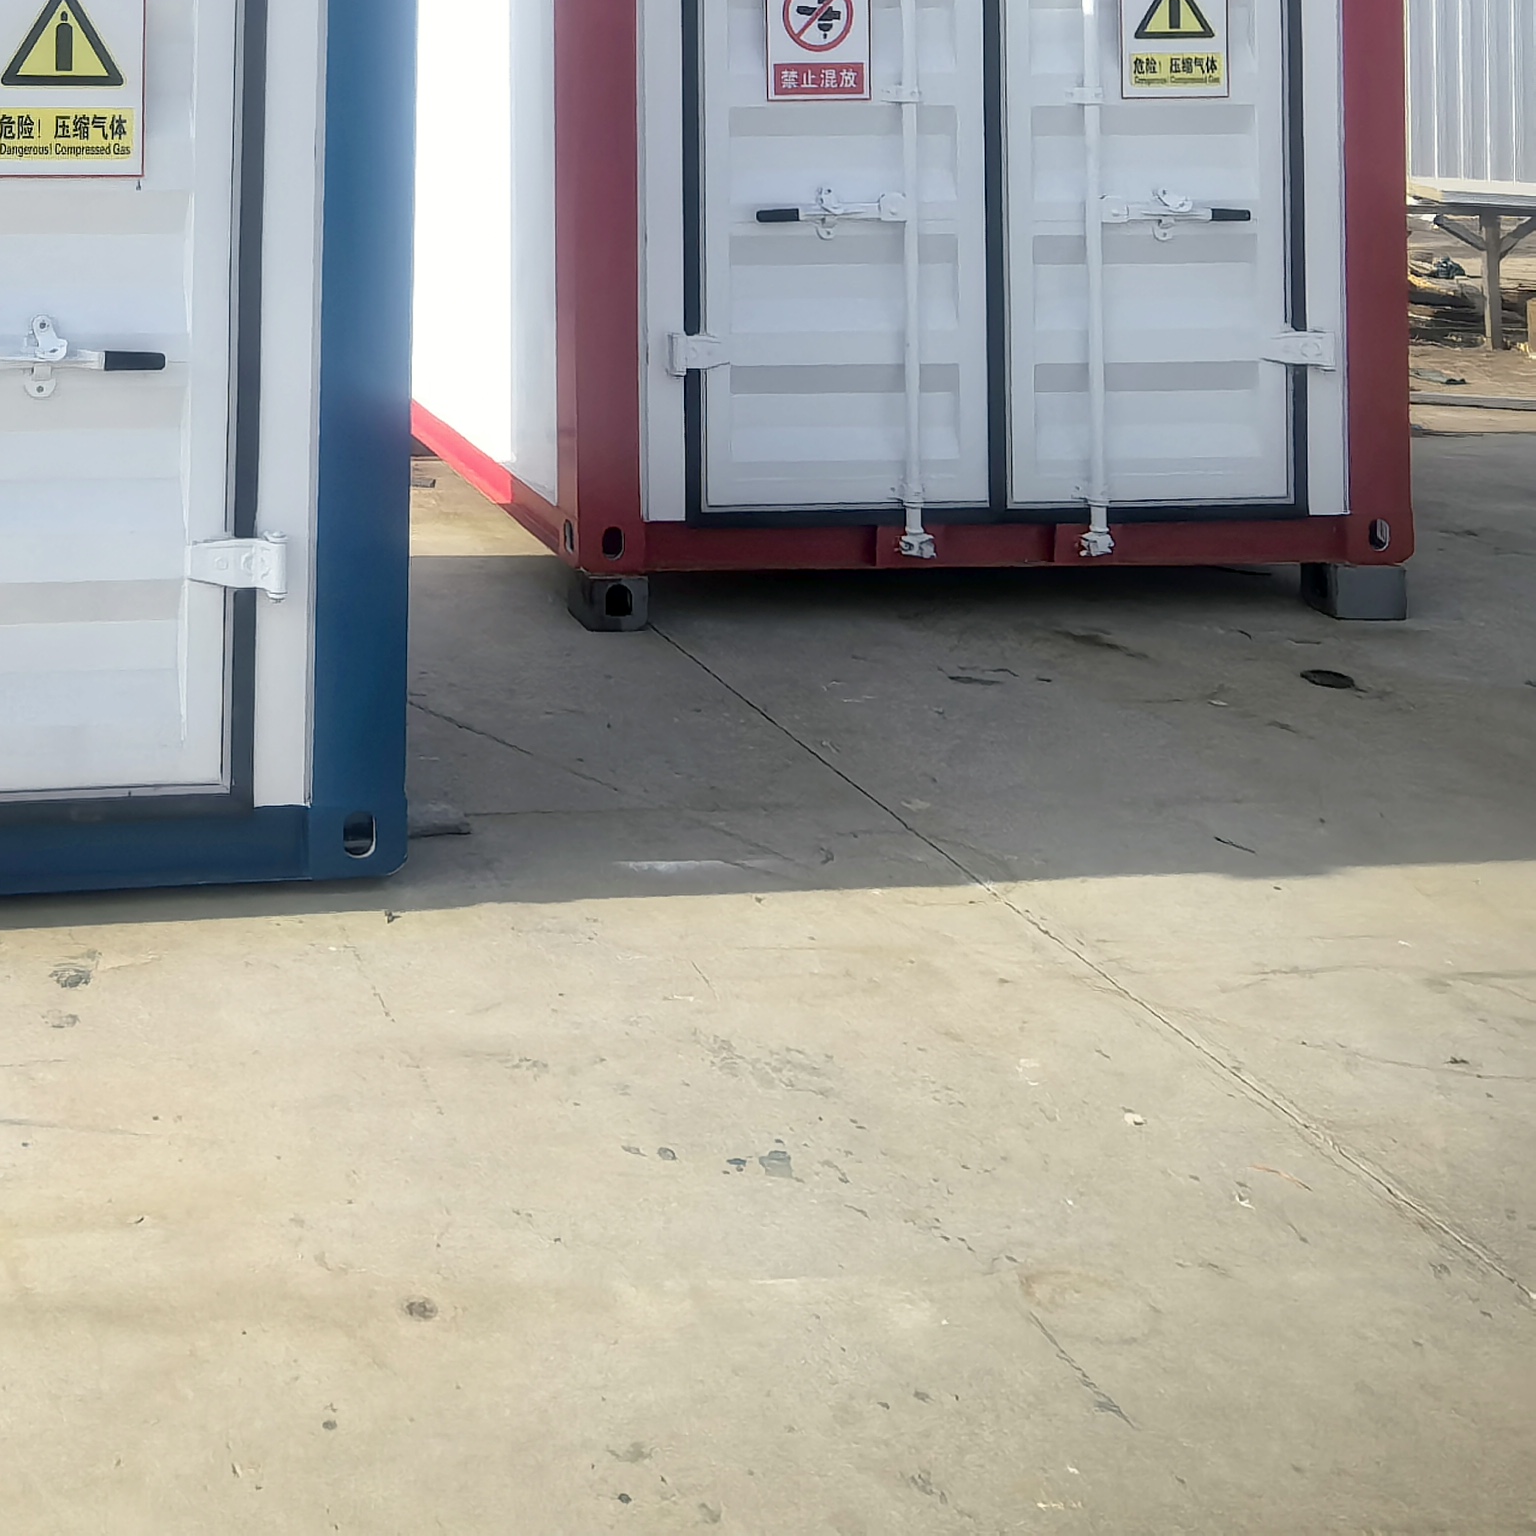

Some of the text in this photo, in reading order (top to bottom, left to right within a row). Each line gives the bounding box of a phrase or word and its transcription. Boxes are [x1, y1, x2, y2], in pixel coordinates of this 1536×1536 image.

[780, 68, 858, 89] 禁止混放
[0, 143, 131, 158] Dangerous! Compressed Gas
